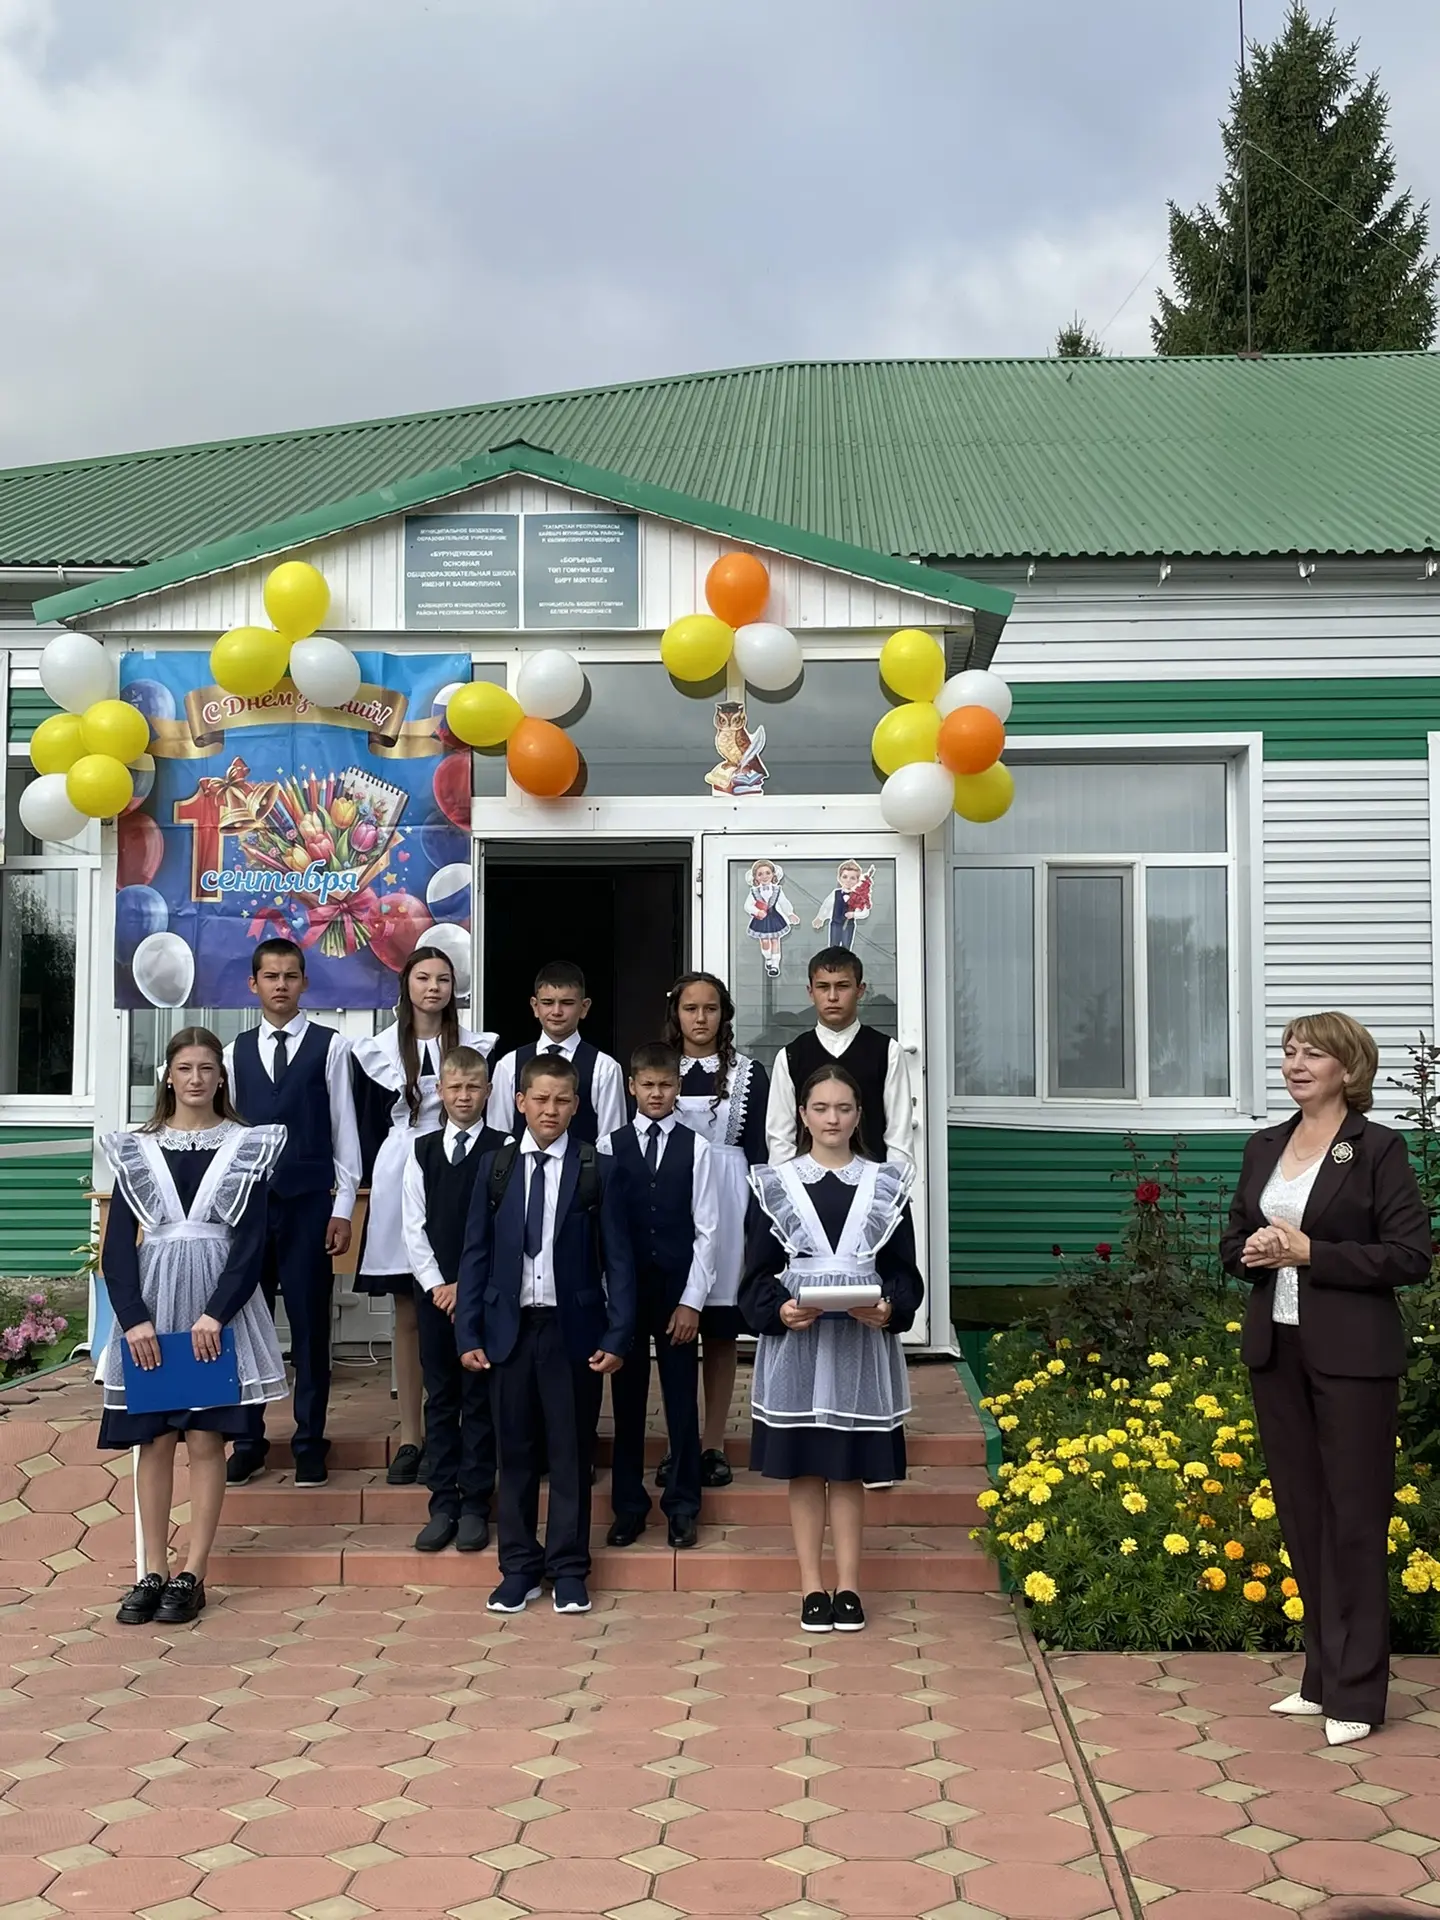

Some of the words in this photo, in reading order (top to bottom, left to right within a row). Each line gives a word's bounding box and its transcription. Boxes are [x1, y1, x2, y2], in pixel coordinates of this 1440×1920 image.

[407, 570, 491, 578] ОБЩЕОБРАЗОВАТЕЛЬНАЯ
[203, 702, 221, 724] С
[173, 778, 221, 902] 1
[200, 858, 359, 904] сентября
